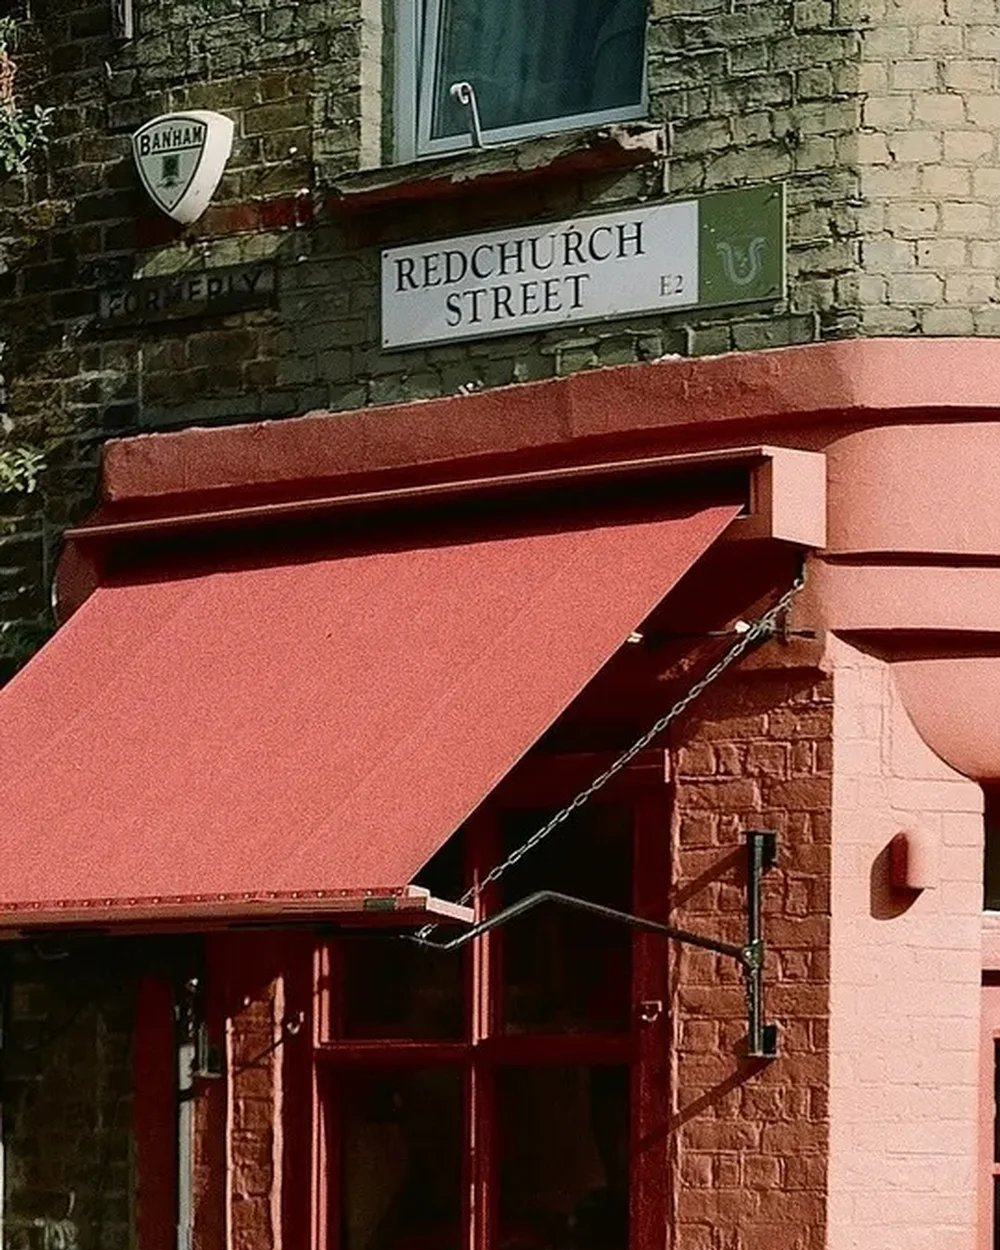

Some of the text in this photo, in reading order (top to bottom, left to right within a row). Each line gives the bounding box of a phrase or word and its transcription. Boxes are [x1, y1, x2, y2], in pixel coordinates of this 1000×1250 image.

[141, 126, 203, 155] BANHAM
[394, 221, 646, 293] REDCHURCH
[446, 274, 684, 327] STREET E2
